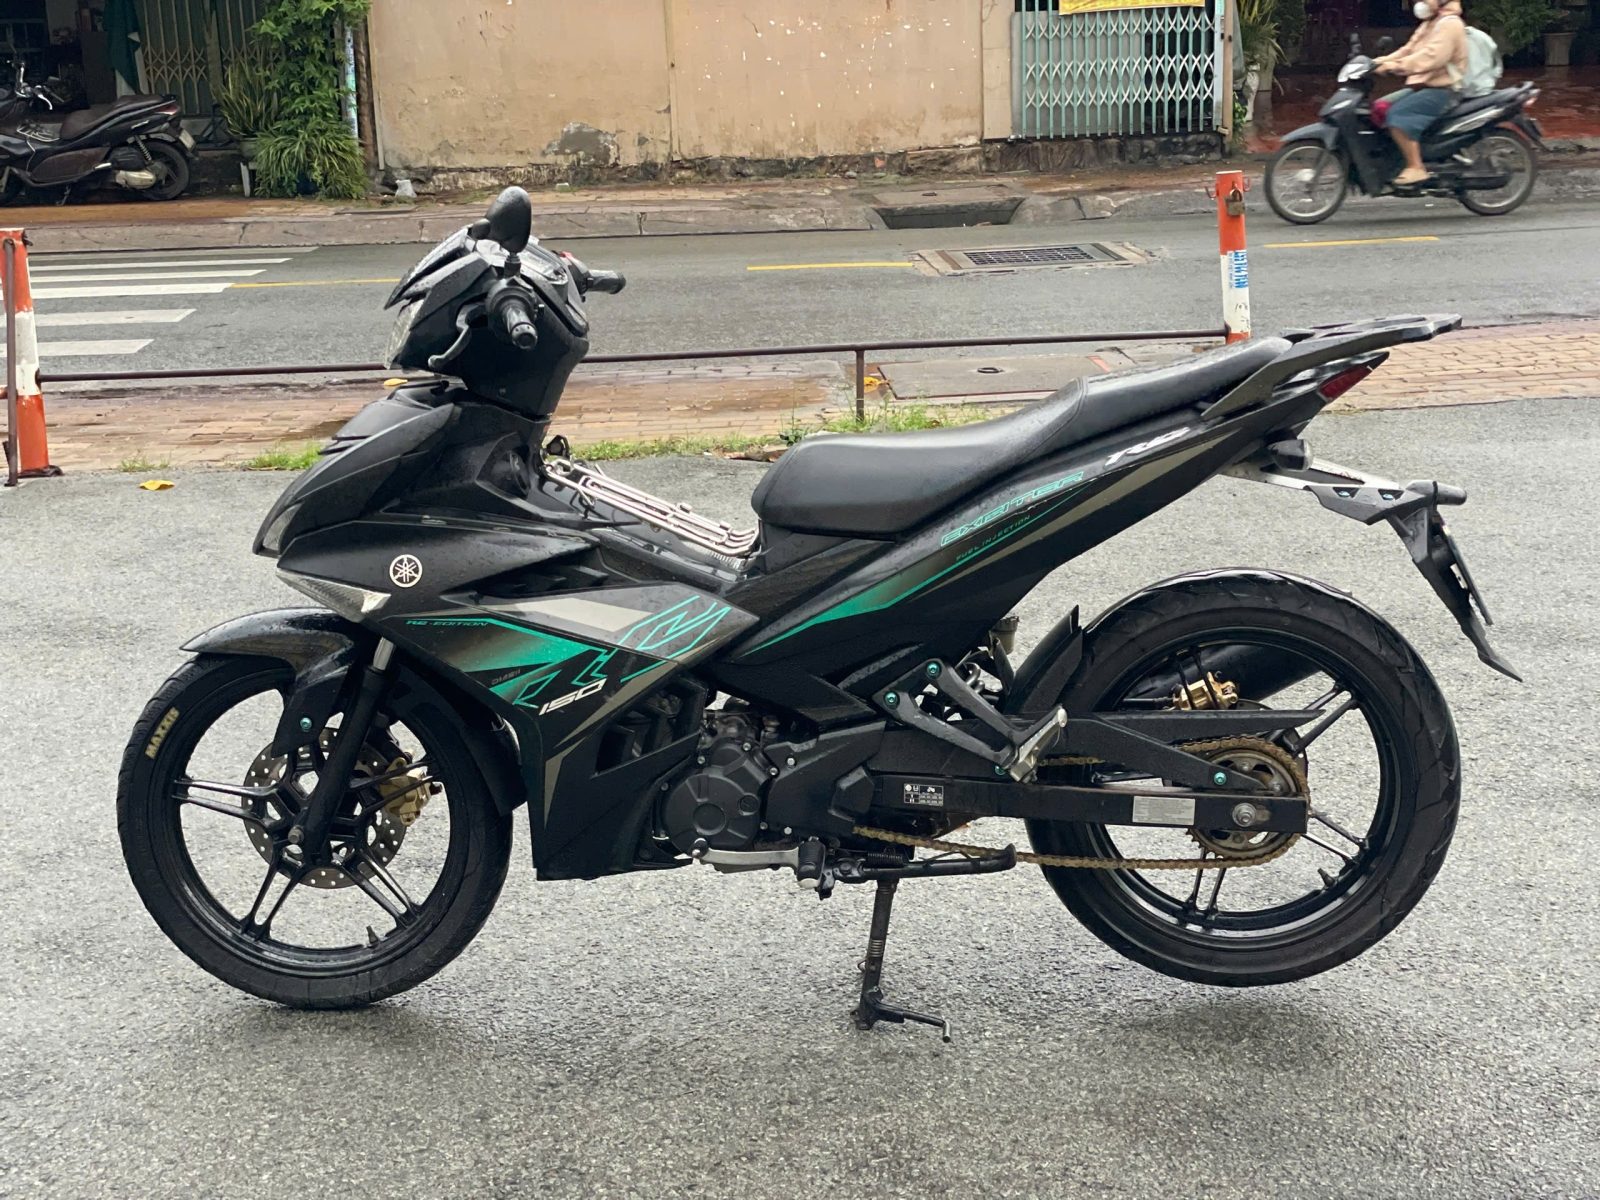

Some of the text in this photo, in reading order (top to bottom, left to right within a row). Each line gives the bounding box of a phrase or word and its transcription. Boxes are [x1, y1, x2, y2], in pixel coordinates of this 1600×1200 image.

[956, 514, 1031, 562] FUEL INJECTION
[538, 678, 608, 716] 150
[144, 706, 180, 760] MAXXIS
